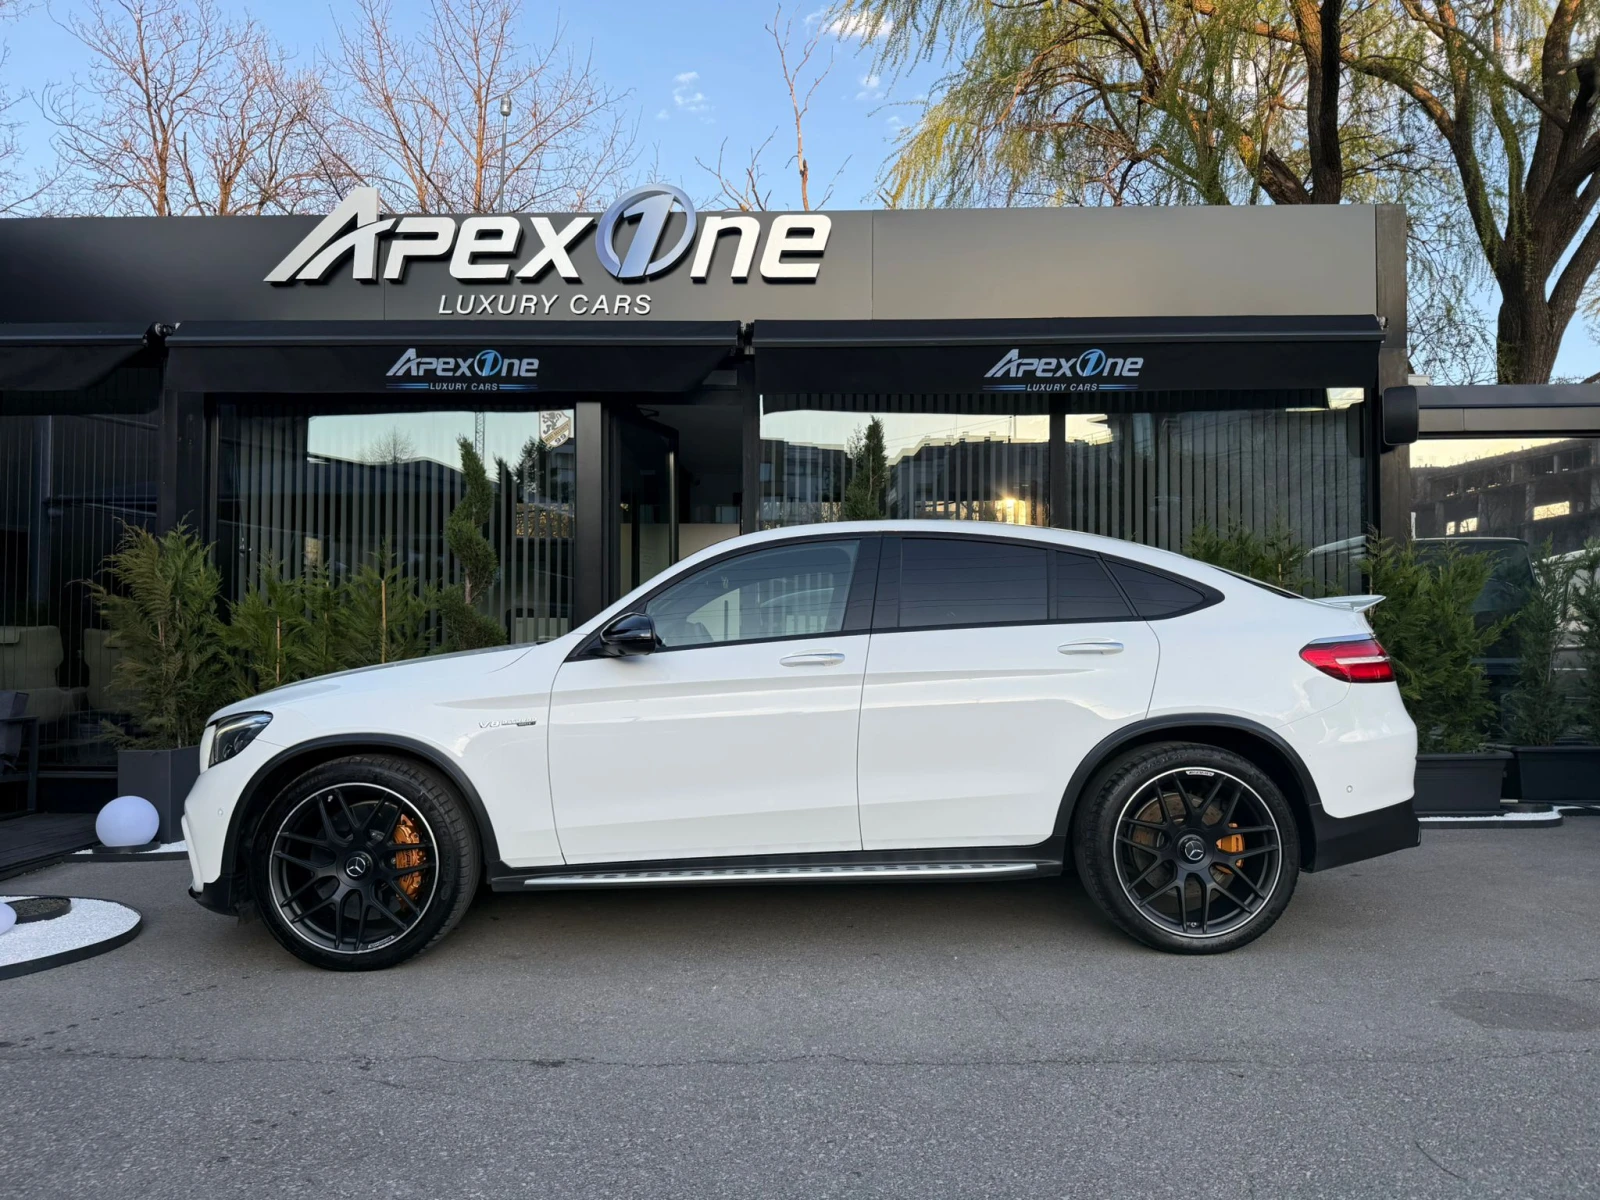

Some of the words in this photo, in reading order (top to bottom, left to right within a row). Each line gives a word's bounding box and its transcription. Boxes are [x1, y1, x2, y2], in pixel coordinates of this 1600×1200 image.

[438, 294, 559, 315] LUXURY
[569, 294, 652, 315] CARS
[429, 382, 468, 391] LUXURY
[471, 382, 498, 391] CARS
[1027, 383, 1067, 391] LUXURY
[1070, 383, 1098, 391] CARS
